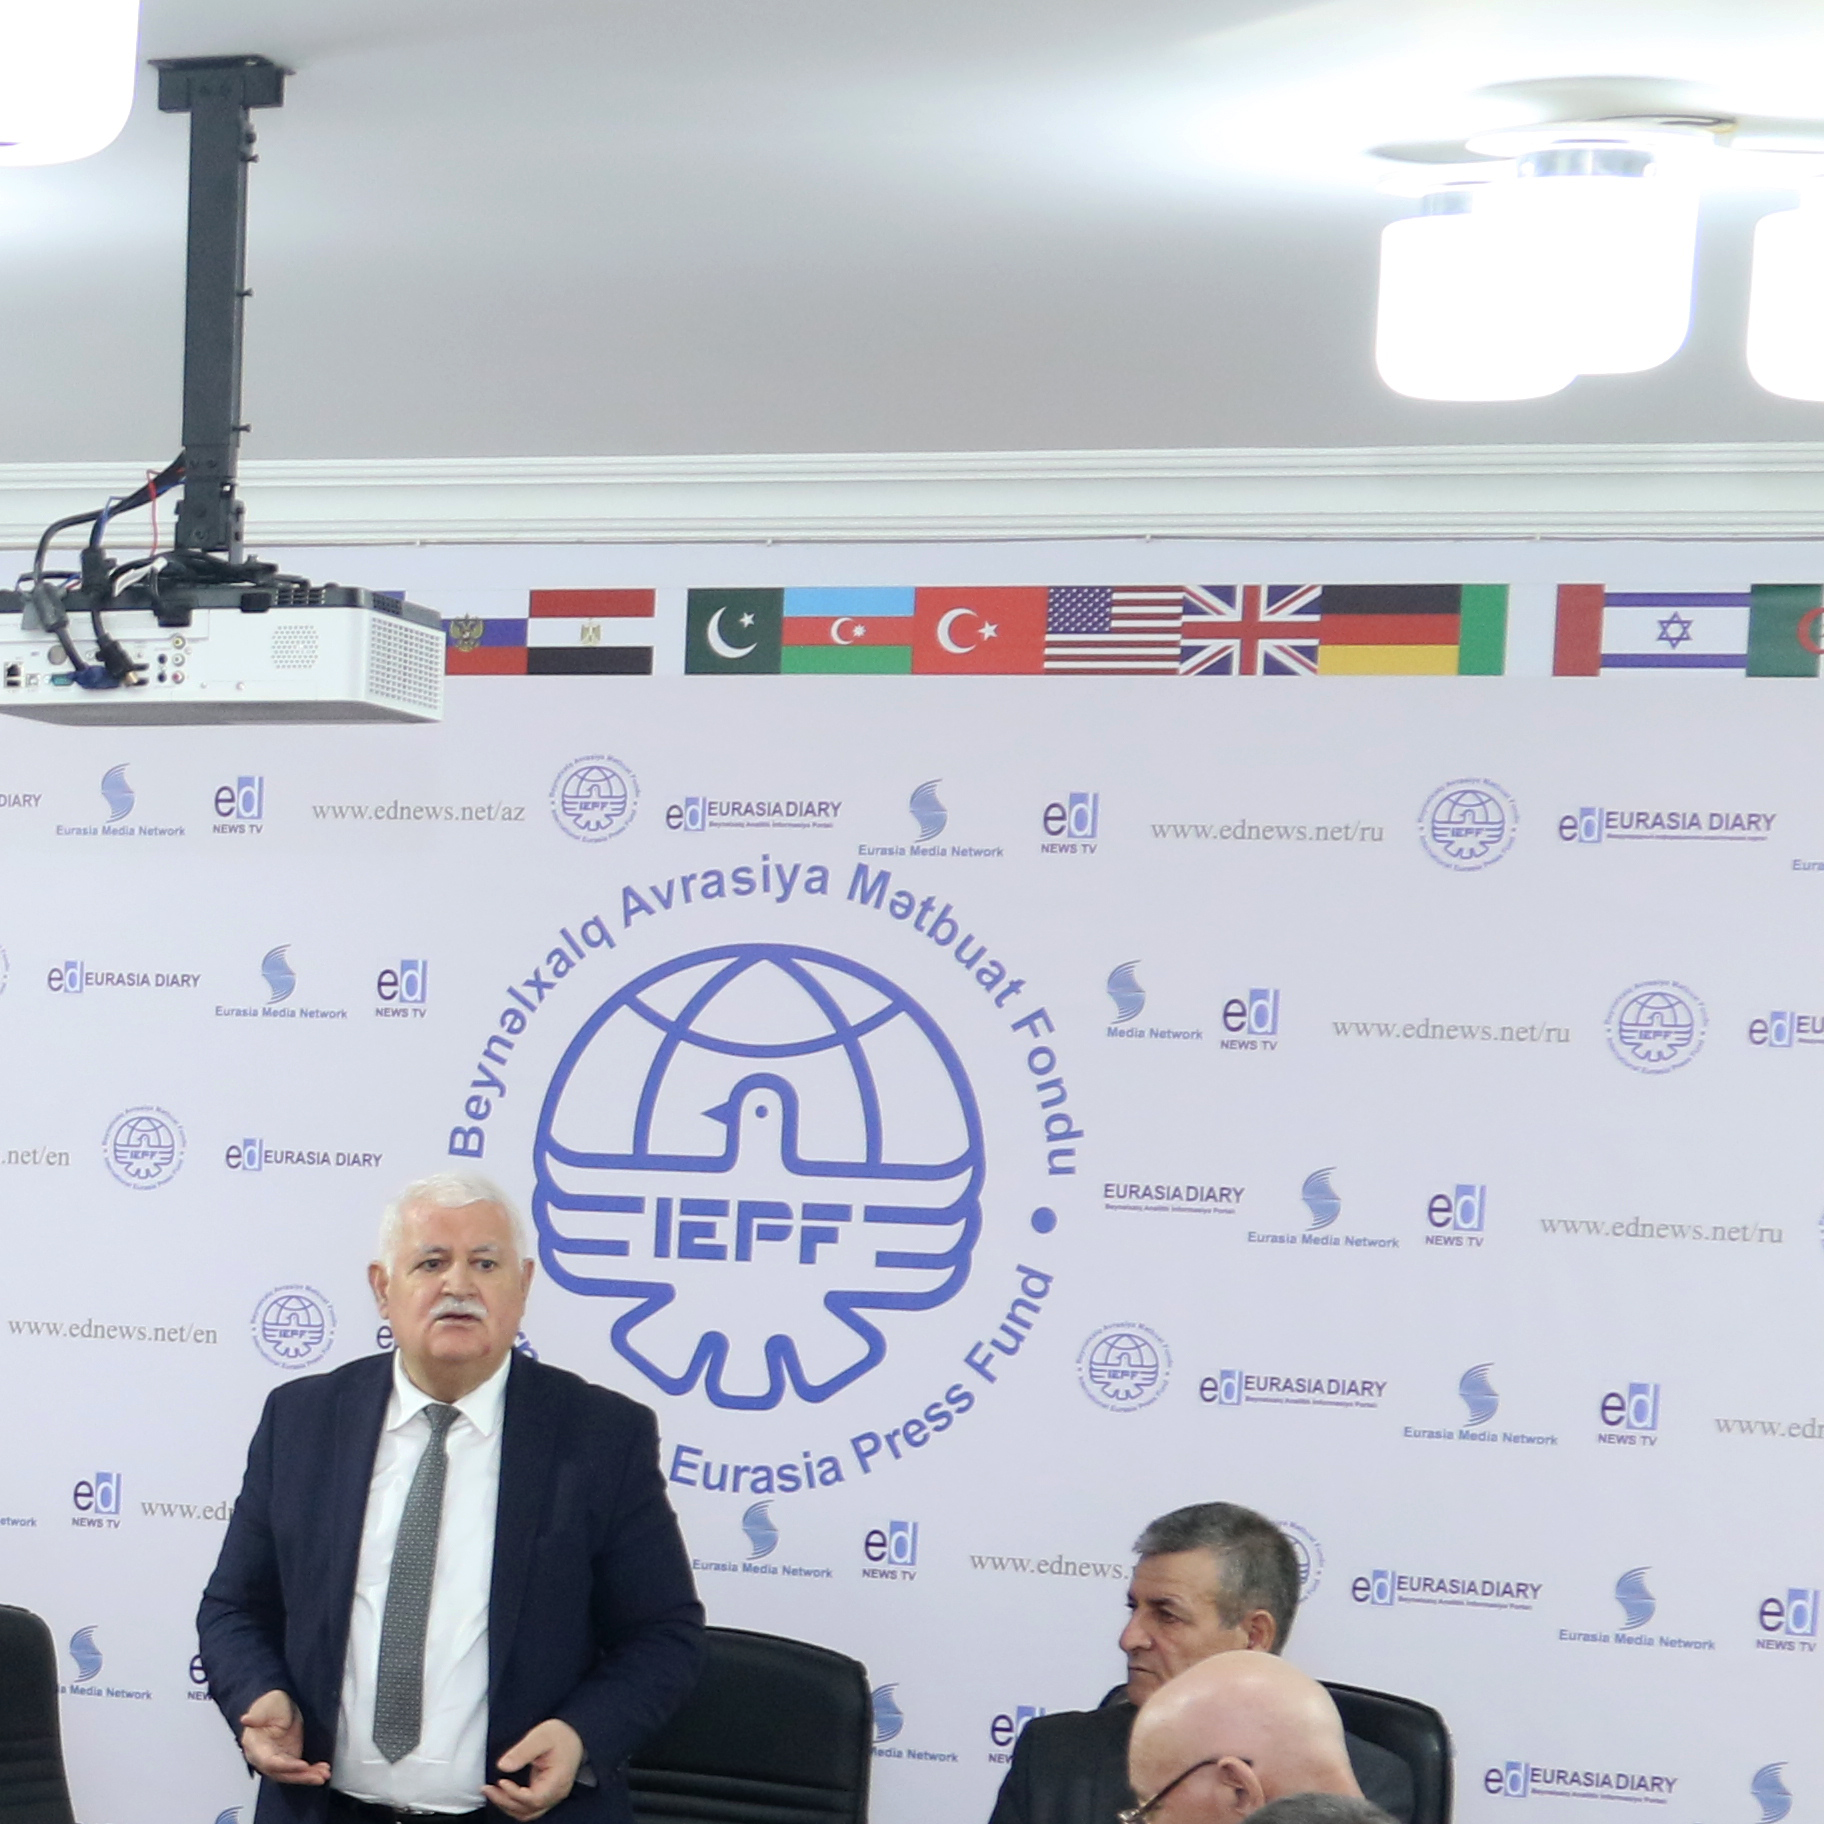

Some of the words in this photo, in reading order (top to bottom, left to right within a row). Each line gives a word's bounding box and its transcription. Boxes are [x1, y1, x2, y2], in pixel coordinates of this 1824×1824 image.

[312, 799, 525, 821] www.ednews.net/az
[56, 825, 98, 835] Eurasia
[102, 826, 135, 836] Media
[139, 826, 185, 836] Network
[213, 824, 245, 834] NEWS
[249, 824, 263, 833] TV
[1150, 819, 1383, 841] www.ednews.net/ru
[1605, 811, 1702, 829] EURASIA
[1708, 813, 1776, 831] DIARY
[858, 844, 906, 856] Eurasia
[910, 845, 947, 856] Media
[951, 846, 1003, 857] Network
[1041, 843, 1077, 854] NEWS
[1081, 844, 1097, 854] TV
[85, 972, 150, 986] EURASIA
[155, 974, 200, 987] DIARY
[449, 911, 617, 1161] Beynəlxalq
[619, 855, 830, 929] Avrasiya
[847, 863, 1027, 1009] Mətbuat
[1011, 1007, 1084, 1178] Fondu
[1332, 1018, 1570, 1043] www.ednews.net/ru
[1220, 1040, 1258, 1050] NEWS
[1261, 1041, 1278, 1050] TV
[654, 1197, 852, 1265] IEPF
[1247, 1231, 1297, 1244] Eurasia
[1301, 1232, 1340, 1245] Media
[1344, 1236, 1399, 1248] Network
[1540, 1216, 1783, 1243] www.ednews.net/ru
[8, 1318, 217, 1344] www.ednews.net/en
[668, 1444, 845, 1495] Eurasia
[850, 1386, 976, 1474] Press
[965, 1264, 1053, 1386] Fund
[1598, 1433, 1636, 1445] NEWS
[1640, 1435, 1657, 1446] TV
[691, 1559, 738, 1572] Eurasia
[742, 1561, 778, 1575] Media
[782, 1565, 832, 1578] Network
[1558, 1629, 1610, 1643] Eurasia
[1613, 1630, 1654, 1646] Media
[1659, 1636, 1715, 1650] Network
